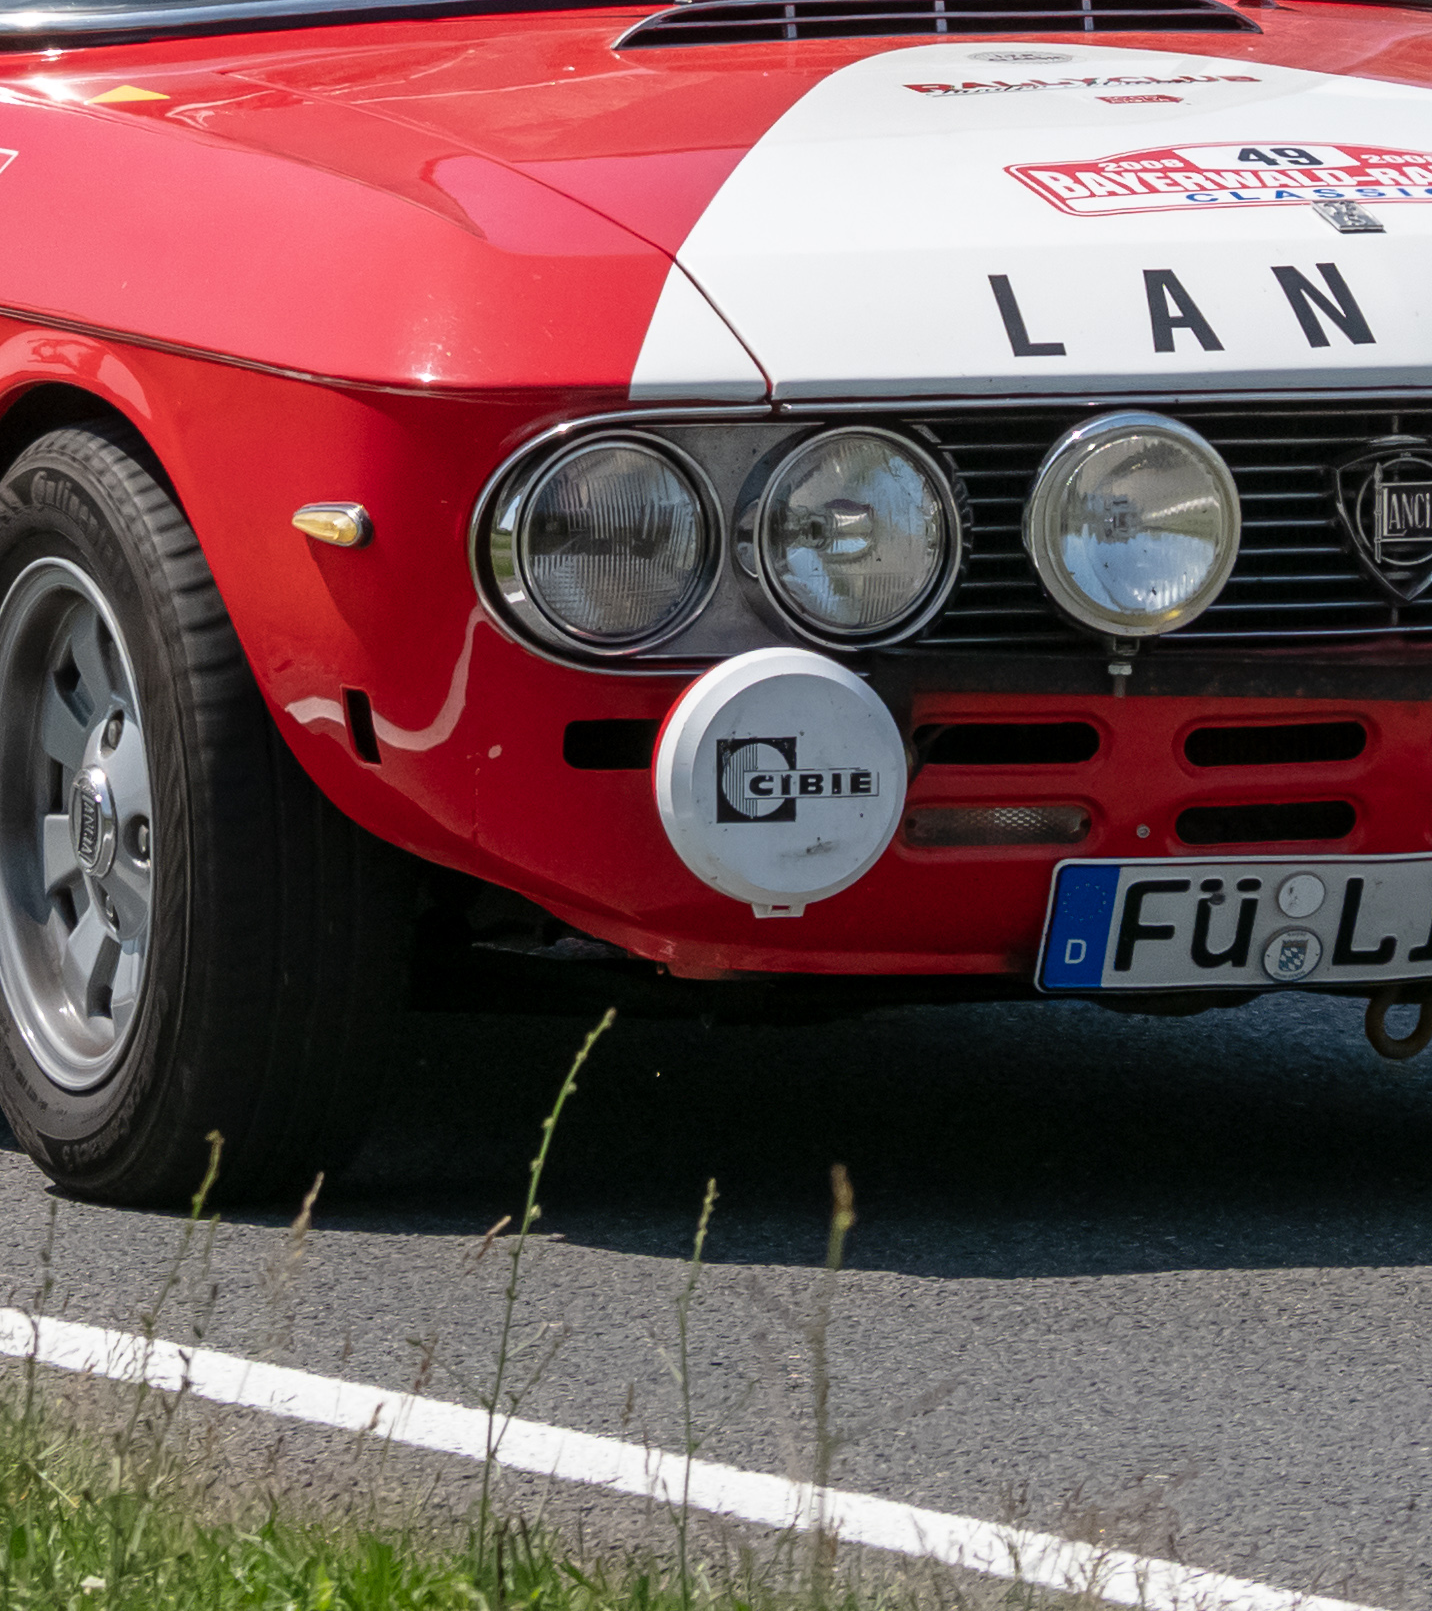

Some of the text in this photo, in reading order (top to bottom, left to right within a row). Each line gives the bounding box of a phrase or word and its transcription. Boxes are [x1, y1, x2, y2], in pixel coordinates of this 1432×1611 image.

[1098, 158, 1185, 172] 2008
[1237, 147, 1324, 166] 49
[749, 772, 872, 797] CIBIE
[1114, 878, 1263, 972] FÜ
[1065, 938, 1087, 965] D
